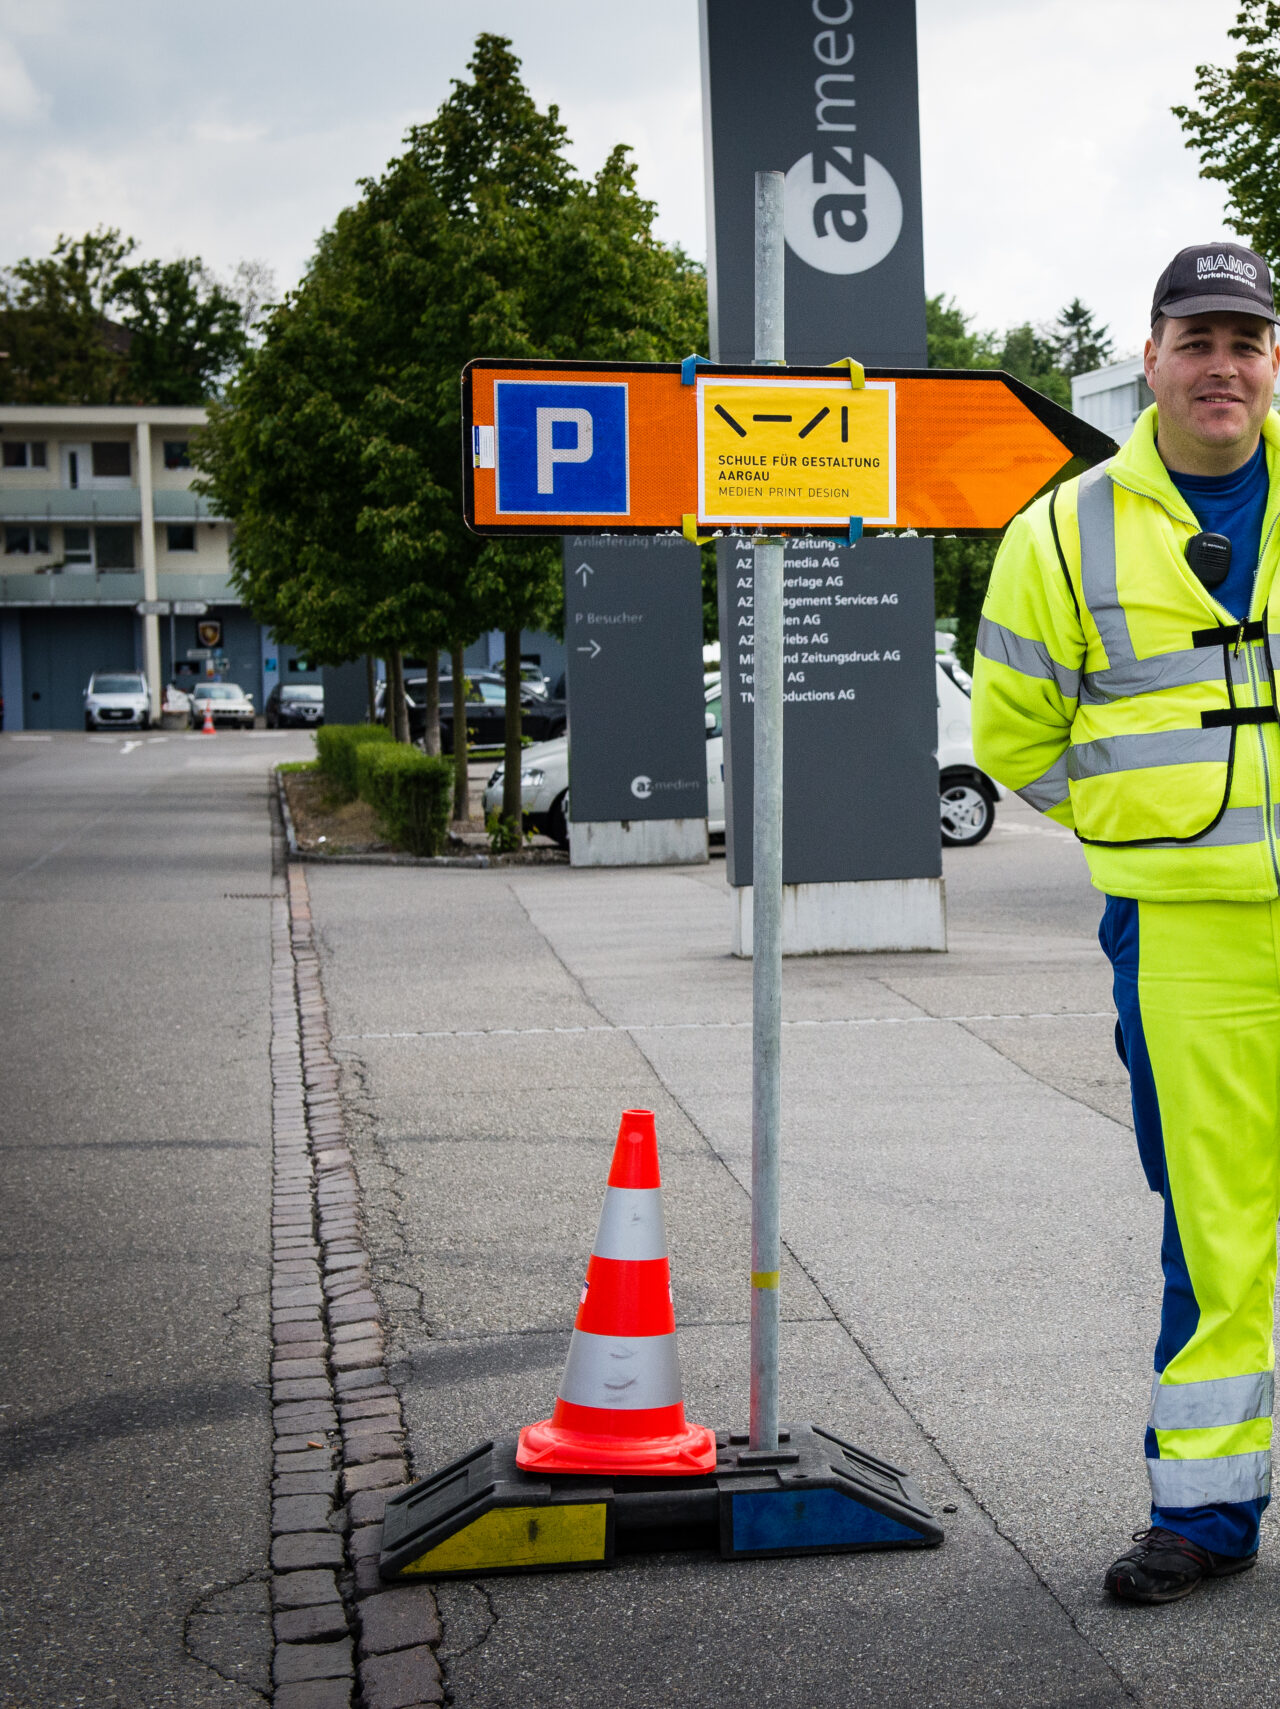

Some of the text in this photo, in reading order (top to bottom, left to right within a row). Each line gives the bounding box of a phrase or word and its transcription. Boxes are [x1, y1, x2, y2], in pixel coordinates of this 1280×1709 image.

[1197, 254, 1257, 280] MAMO
[1197, 272, 1256, 290] Verkehrsdienst
[536, 407, 593, 494] P
[718, 453, 880, 468] SCHULE FÜR GESTALTUNG
[718, 471, 770, 481] AARGAU
[718, 487, 849, 498] MEDIEN PRINT DESIGN
[792, 539, 836, 551] Zeitung
[736, 557, 840, 569] AZ media AG
[737, 576, 844, 589] AZ verlage AG
[737, 594, 898, 609] AZ agement Services AG
[587, 611, 643, 624] Besucher
[738, 616, 754, 627] AZ
[803, 614, 821, 625] AG
[739, 635, 754, 646] AZ
[811, 633, 829, 644] AG
[801, 651, 880, 665] Zeitungsdruck
[883, 650, 900, 661] AG
[788, 672, 805, 683] AG
[783, 689, 835, 701] oductions
[837, 689, 855, 700] AG
